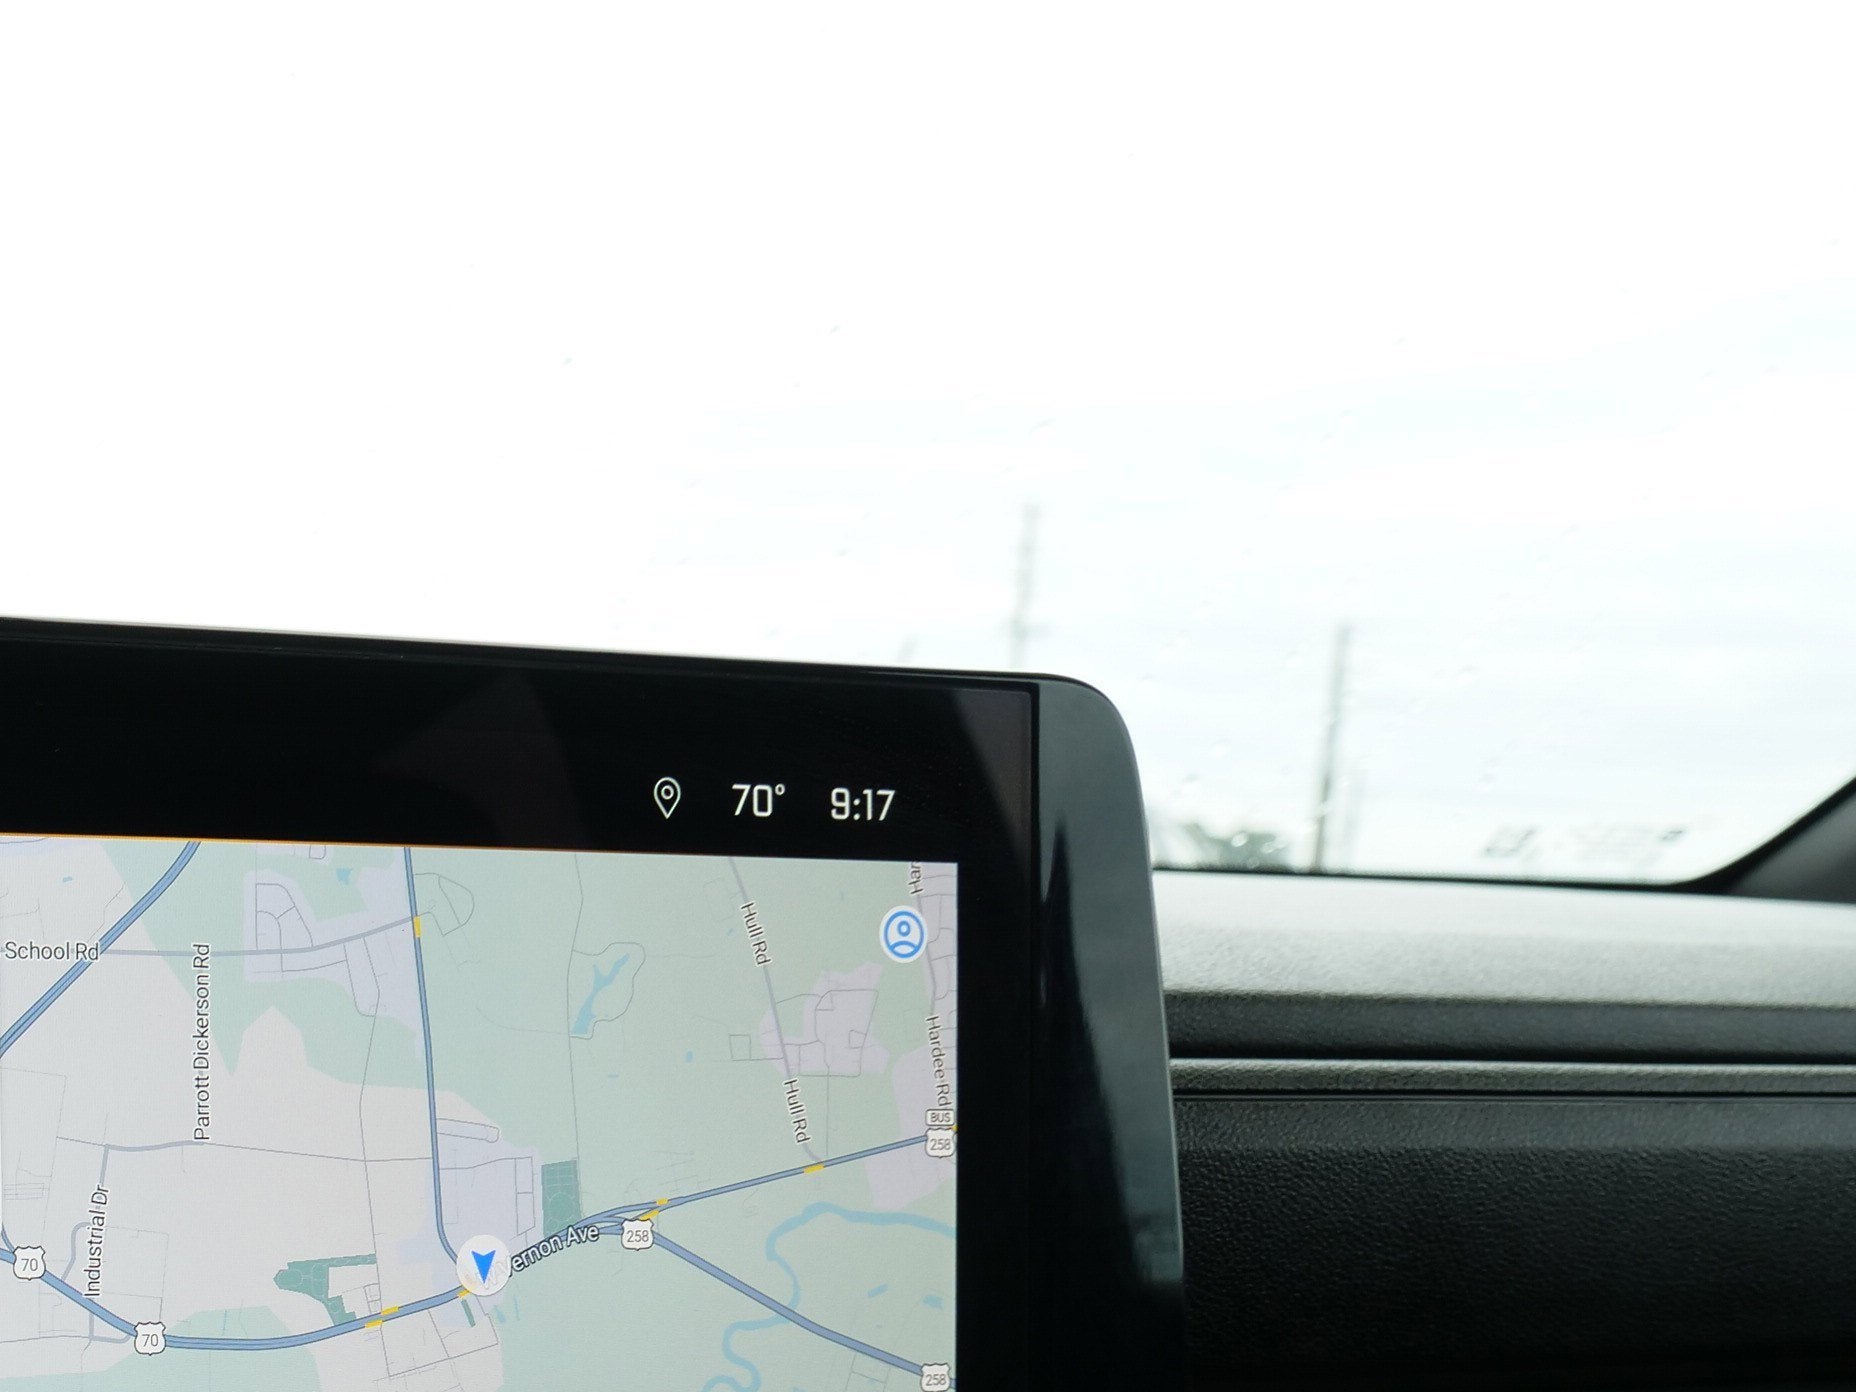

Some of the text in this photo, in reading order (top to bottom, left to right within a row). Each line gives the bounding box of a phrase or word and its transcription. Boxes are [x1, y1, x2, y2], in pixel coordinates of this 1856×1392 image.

[731, 783, 786, 818] 70°
[830, 787, 896, 822] 9:17
[741, 902, 772, 966] Hull Rd
[5, 940, 99, 961] School Rd
[193, 944, 211, 1141] Parrott Dickerson Rd
[926, 1016, 952, 1108] Hardee Rd
[784, 1079, 811, 1144] Hull Rd
[930, 1112, 951, 1123] BUS
[929, 1138, 952, 1151] 258
[83, 1185, 110, 1297] Industrial Dr
[566, 1223, 600, 1249] Ave
[625, 1229, 650, 1243] 258
[21, 1258, 39, 1272] 70
[141, 1333, 160, 1348] 70
[925, 1374, 947, 1387] 258
